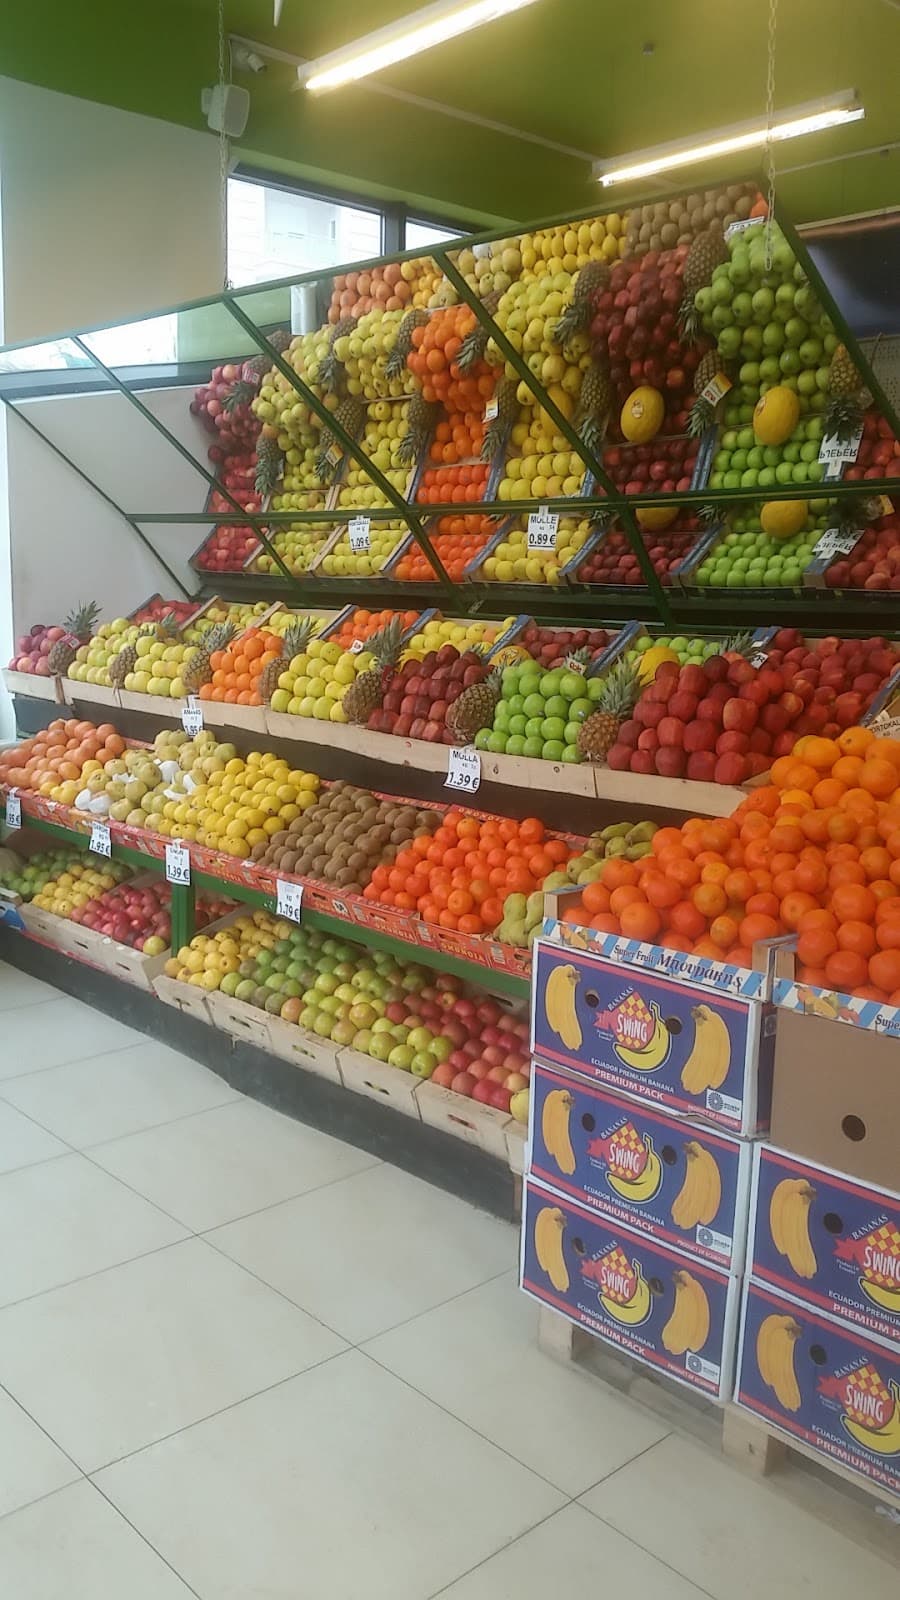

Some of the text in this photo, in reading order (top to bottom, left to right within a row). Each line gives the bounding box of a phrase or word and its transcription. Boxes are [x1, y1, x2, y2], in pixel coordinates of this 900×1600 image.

[529, 533, 548, 545] 0.89
[449, 771, 471, 787] 1.39
[167, 864, 182, 878] 1.39
[616, 1013, 648, 1043] SWING
[875, 1013, 900, 1031] Supe
[594, 1068, 665, 1101] PREMIUM PACK
[609, 1143, 641, 1174] SWING
[586, 1195, 654, 1233] PREMIUM PACK
[852, 1213, 888, 1240] BANANAS
[601, 1266, 630, 1299] SWING
[828, 1289, 865, 1311] ECUADOR
[833, 1301, 889, 1335] PREMIUM
[580, 1313, 646, 1357] PREMIUM PACK
[834, 1355, 869, 1378] BANANAS
[844, 1383, 885, 1423] SWING
[815, 1437, 871, 1476] PREMIUM
